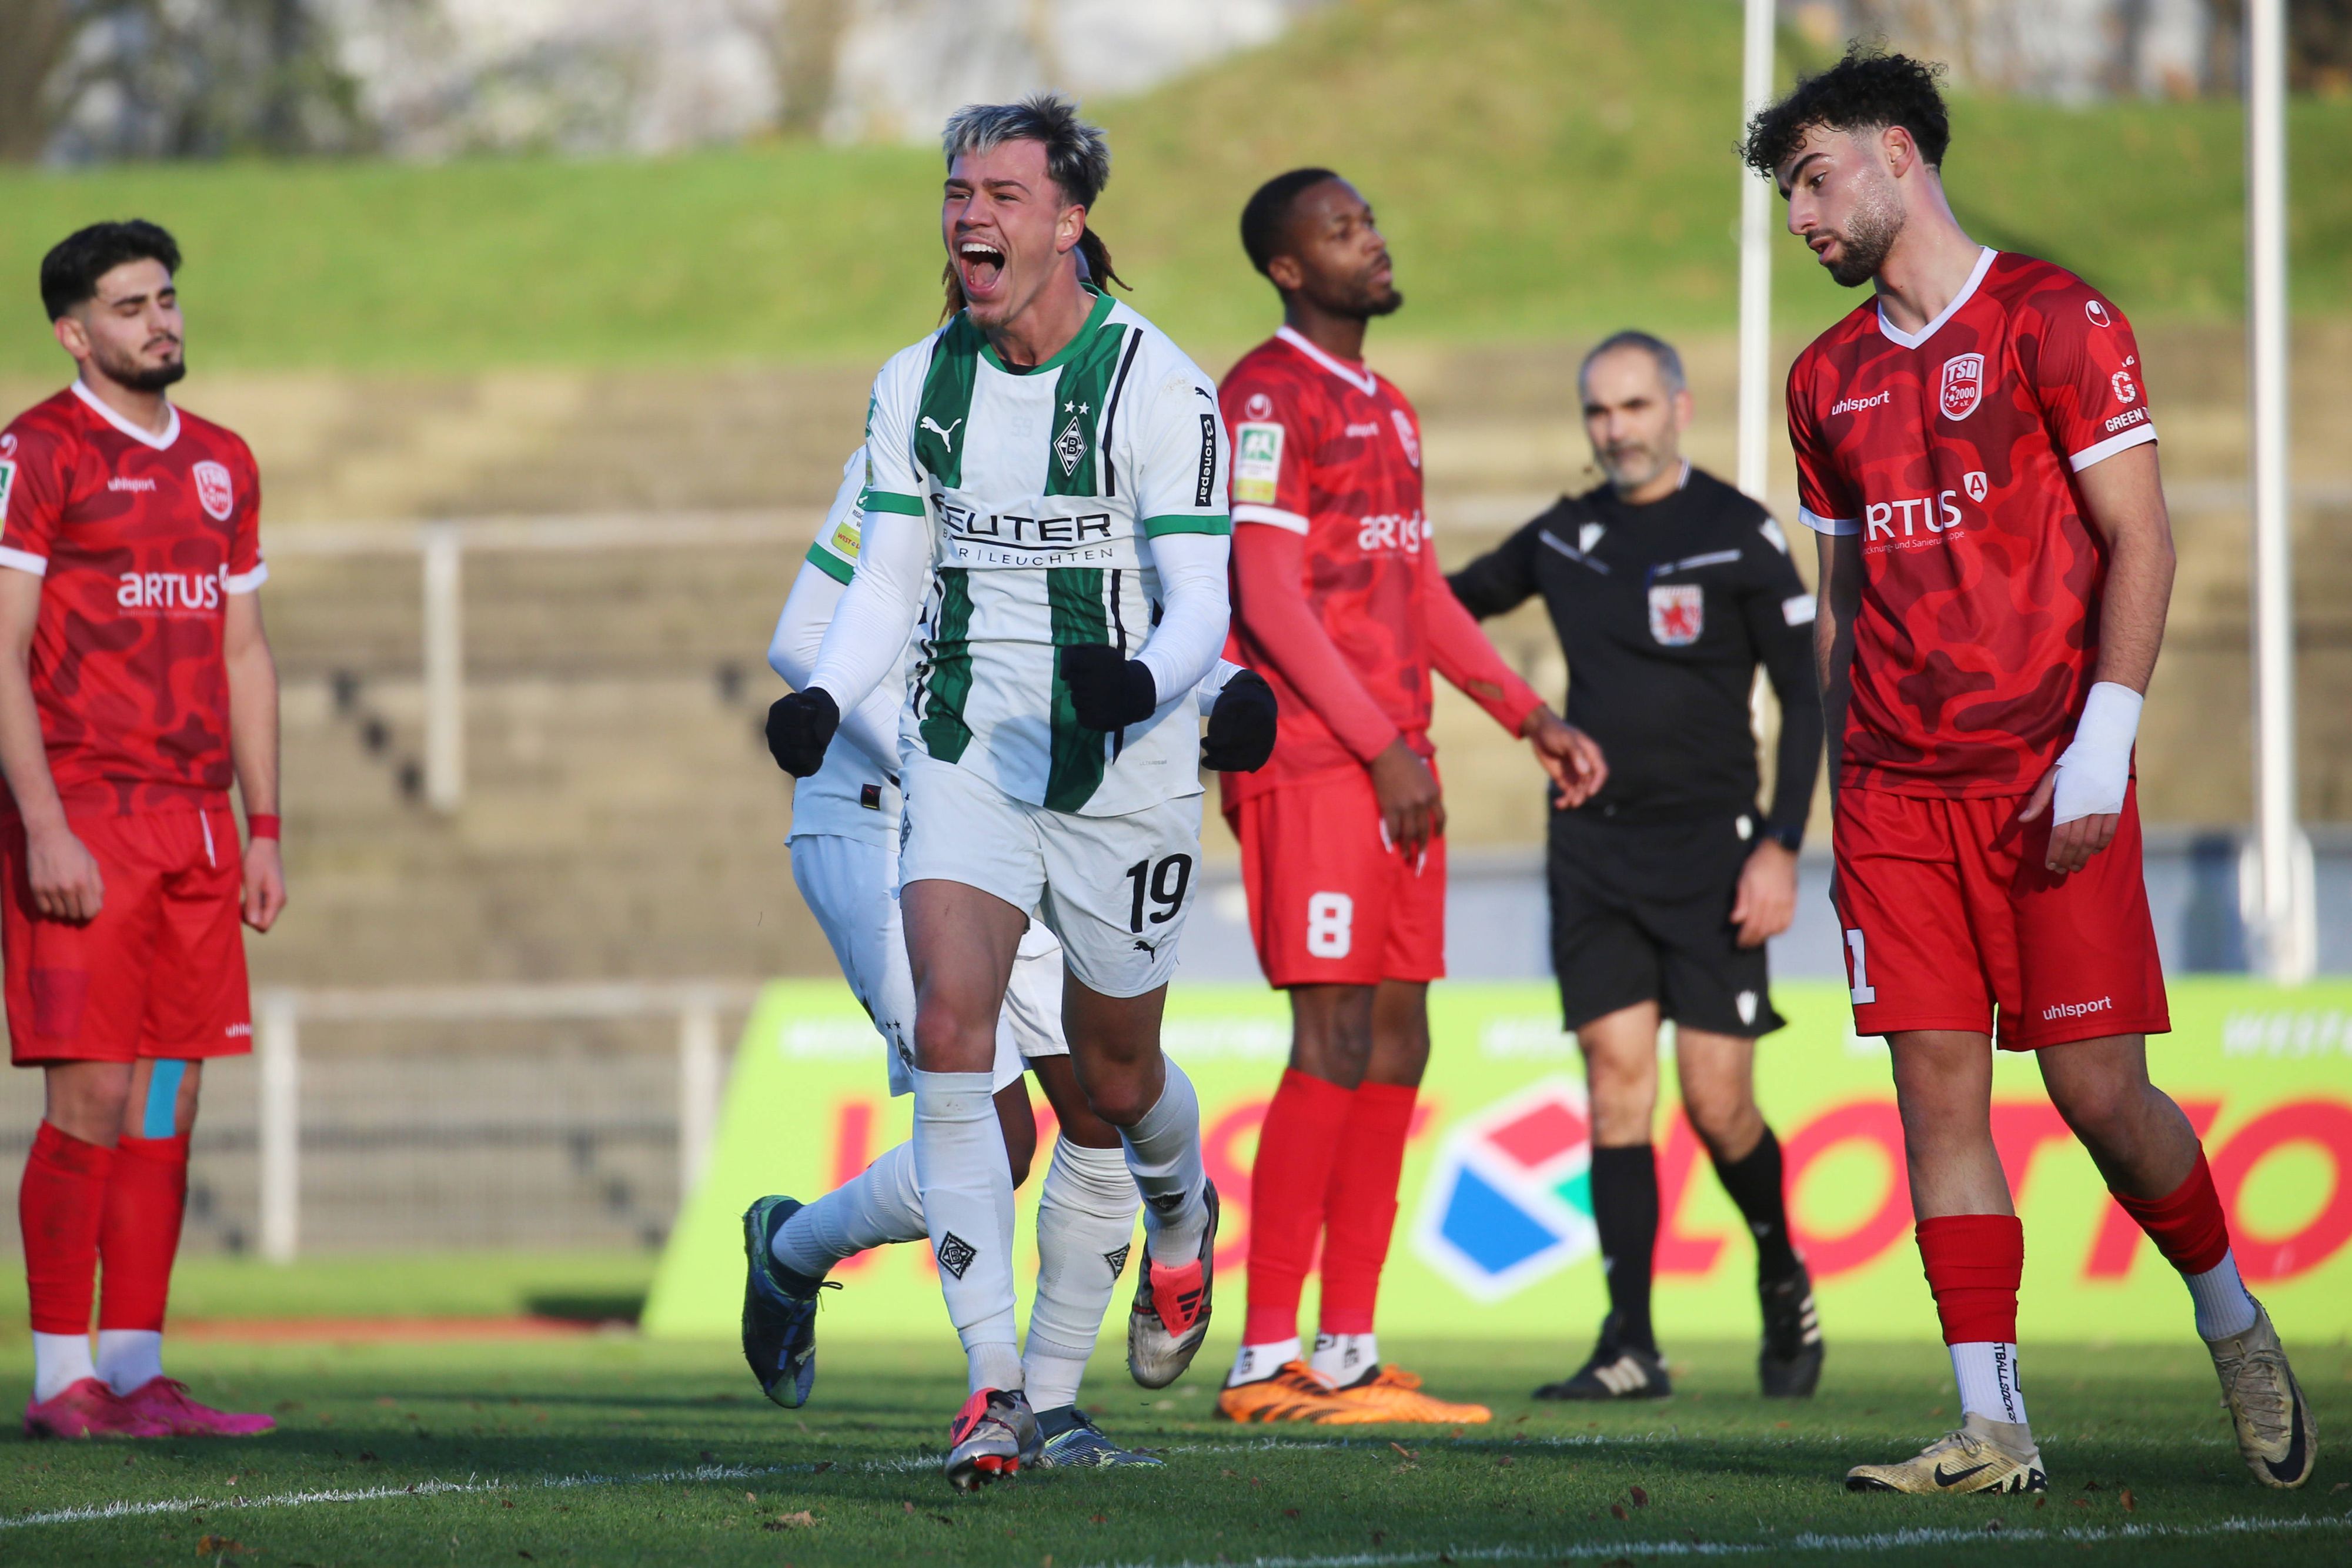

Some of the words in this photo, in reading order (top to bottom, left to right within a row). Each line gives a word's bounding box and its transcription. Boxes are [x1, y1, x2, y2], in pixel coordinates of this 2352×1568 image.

[1948, 360, 1977, 383] TSD
[1832, 390, 1890, 415] uhlsport
[1955, 387, 1975, 400] 2000
[2105, 408, 2144, 432] GREEN
[1200, 439, 1212, 503] sonepar
[1864, 490, 1962, 542] RTUS
[989, 548, 1113, 566] LEUCHTEN
[1863, 544, 1893, 555] ocknung-
[1895, 540, 1910, 549] und
[1126, 853, 1192, 934] 19
[1307, 891, 1353, 959] 8
[2043, 995, 2112, 1020] uhlsport
[1993, 1342, 2017, 1423] TBALLSOCKS
